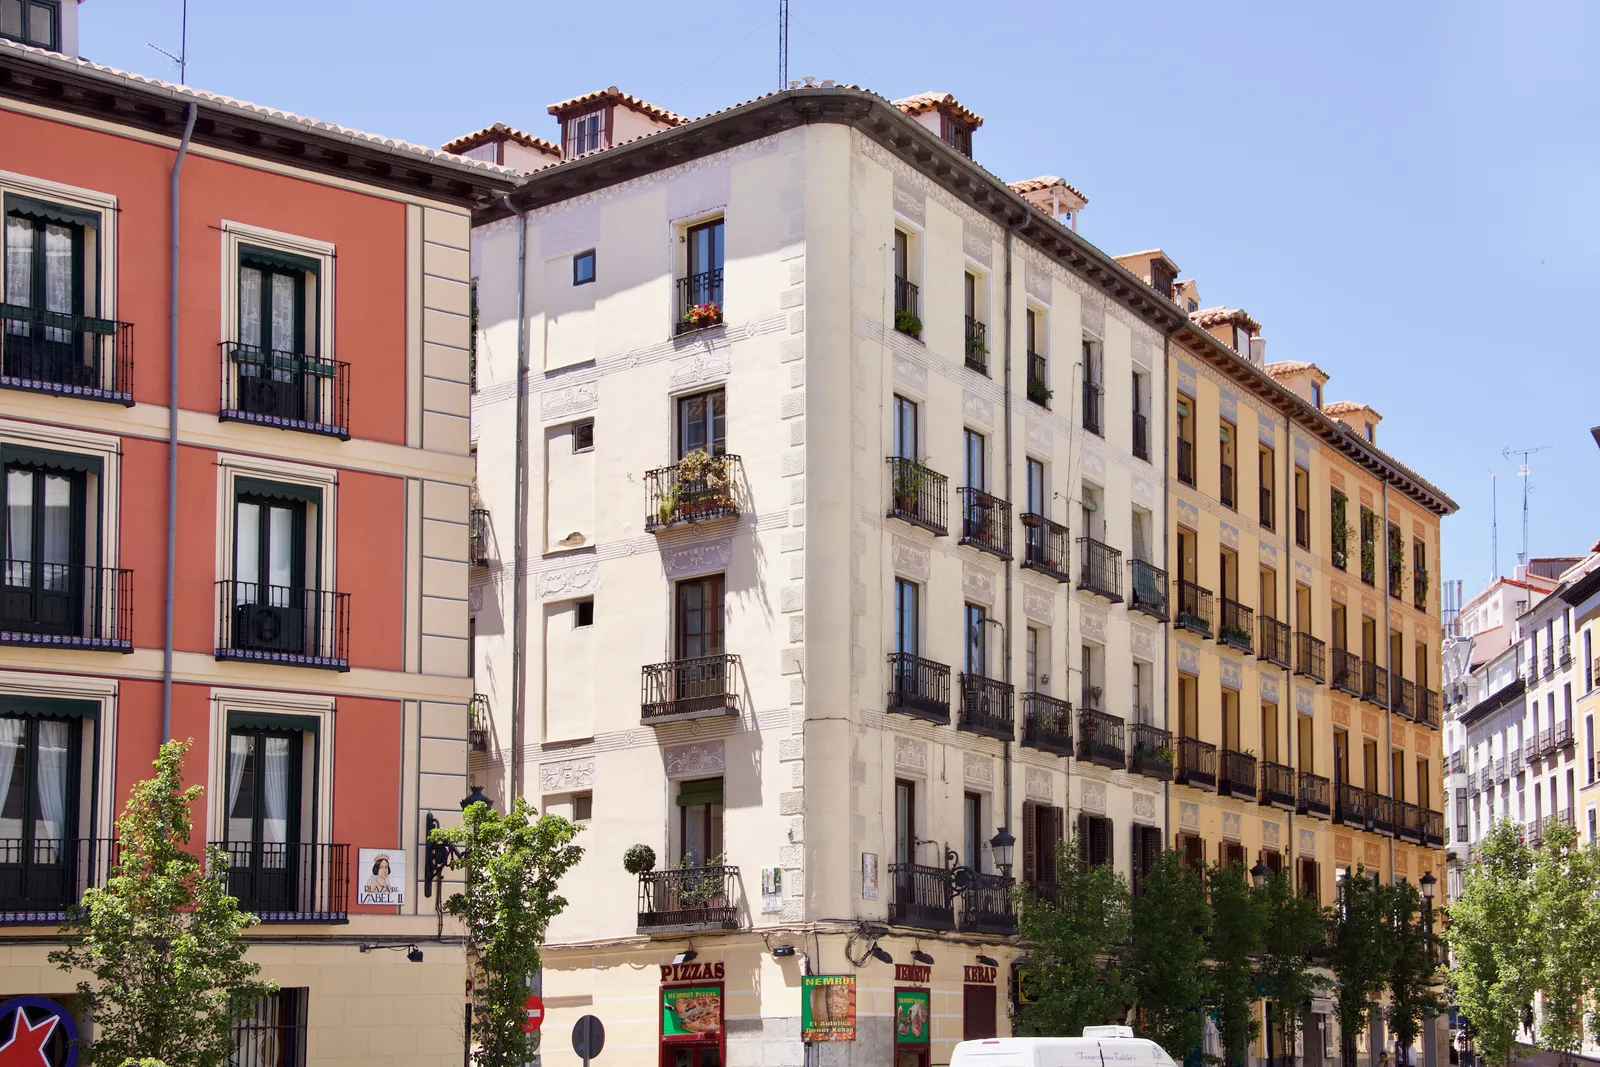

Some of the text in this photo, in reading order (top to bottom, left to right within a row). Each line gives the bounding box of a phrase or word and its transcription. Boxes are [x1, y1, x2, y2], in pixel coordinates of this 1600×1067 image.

[364, 885, 391, 893] PLAZA
[360, 893, 403, 904] ISABEL II
[660, 961, 725, 982] PIZZAS
[963, 965, 997, 984] KEBAP
[805, 977, 855, 986] NEMRUT
